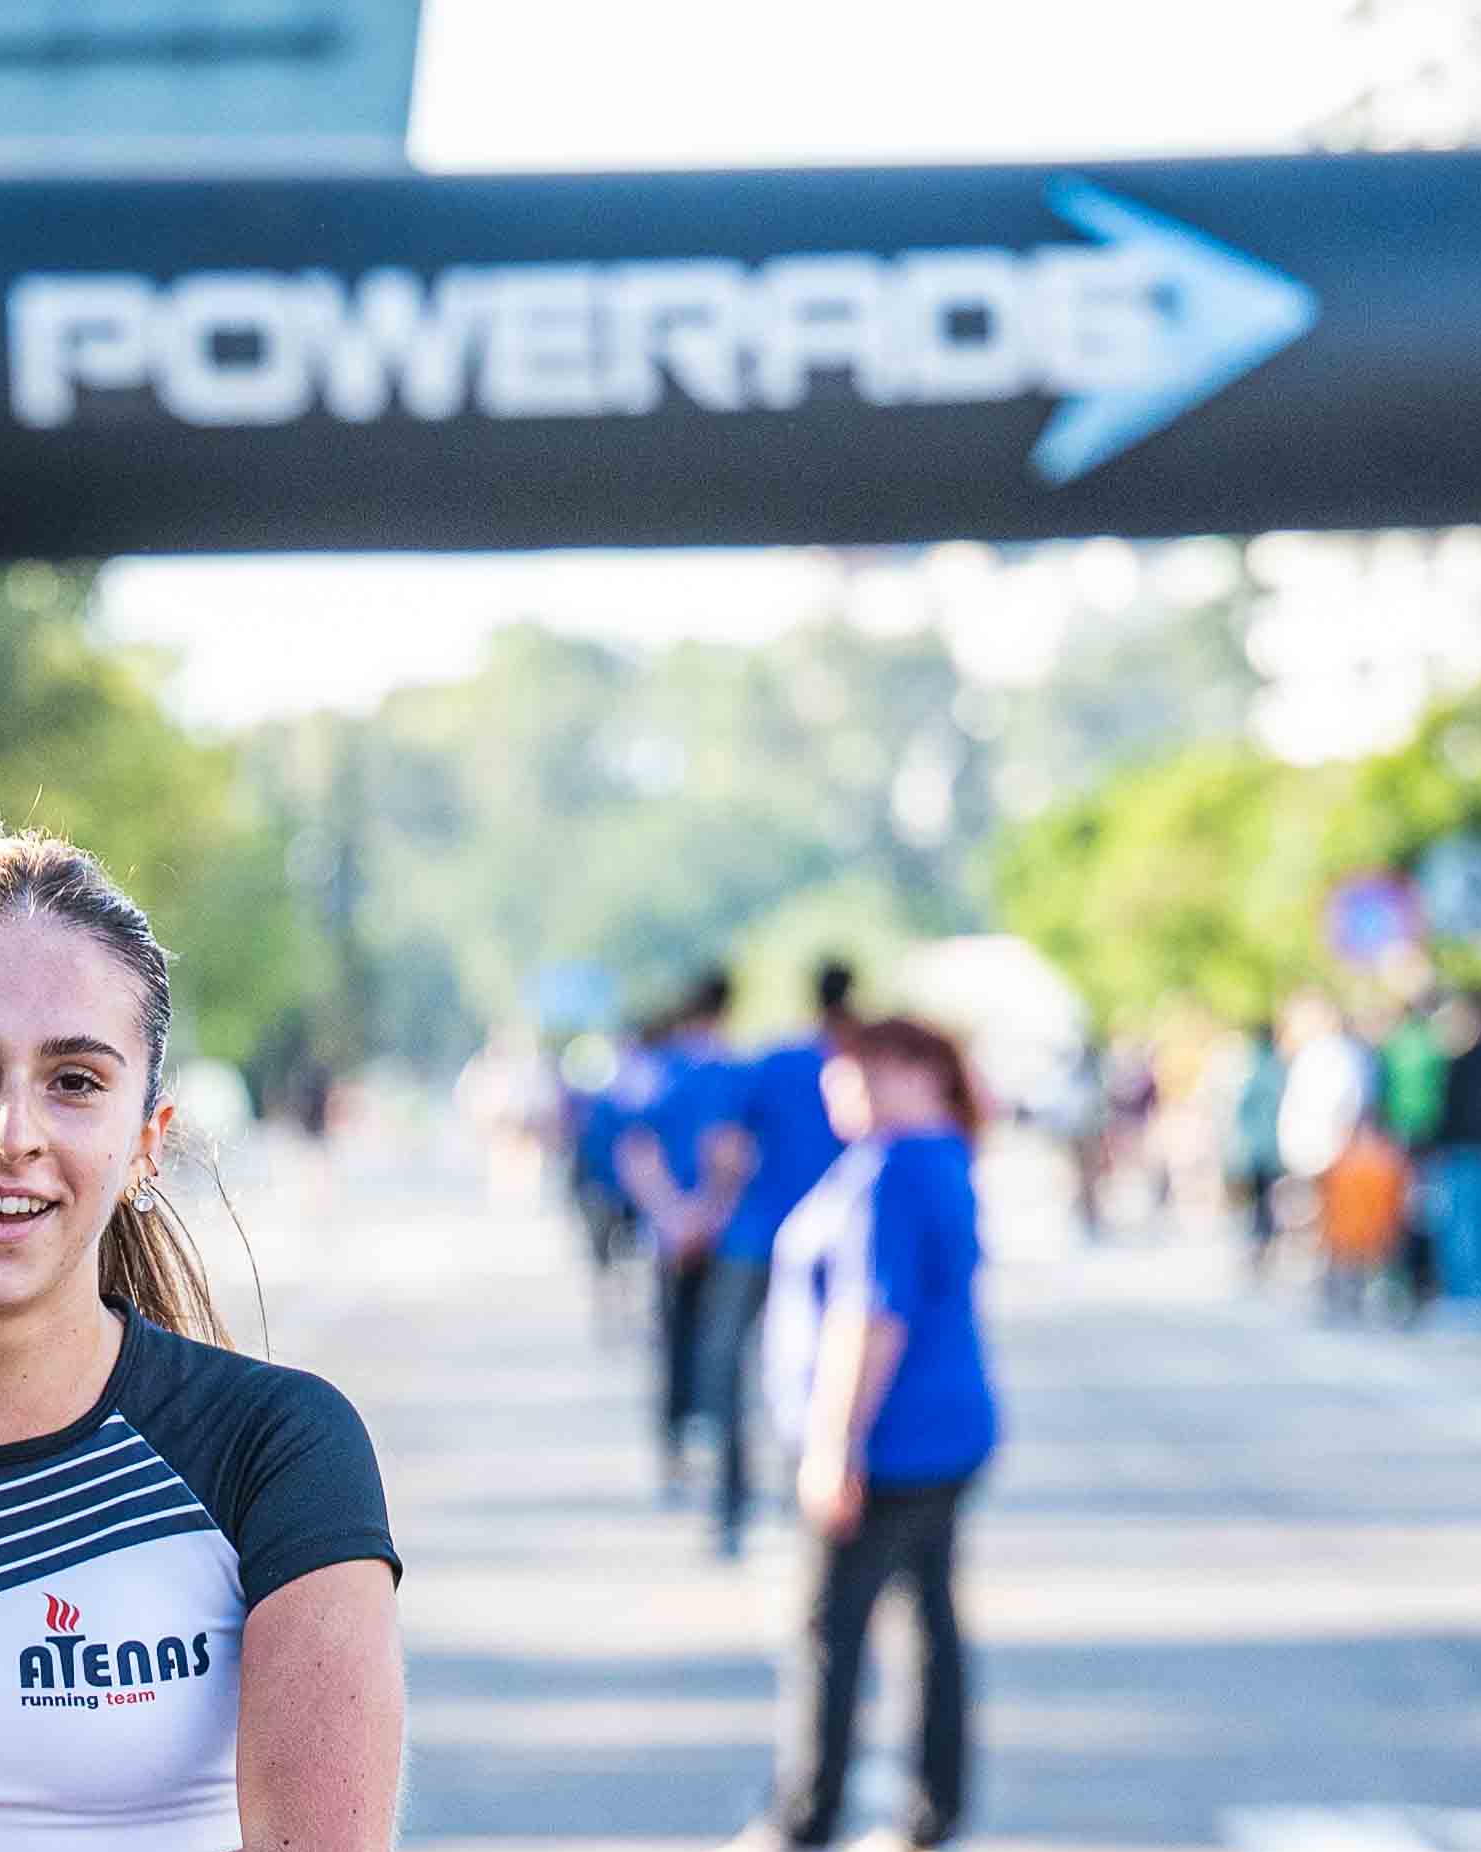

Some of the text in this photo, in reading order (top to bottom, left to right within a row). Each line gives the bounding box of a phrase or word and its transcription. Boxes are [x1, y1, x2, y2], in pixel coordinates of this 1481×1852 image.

[19, 1631, 211, 1689] ATENAS
[21, 1689, 156, 1710] running team
